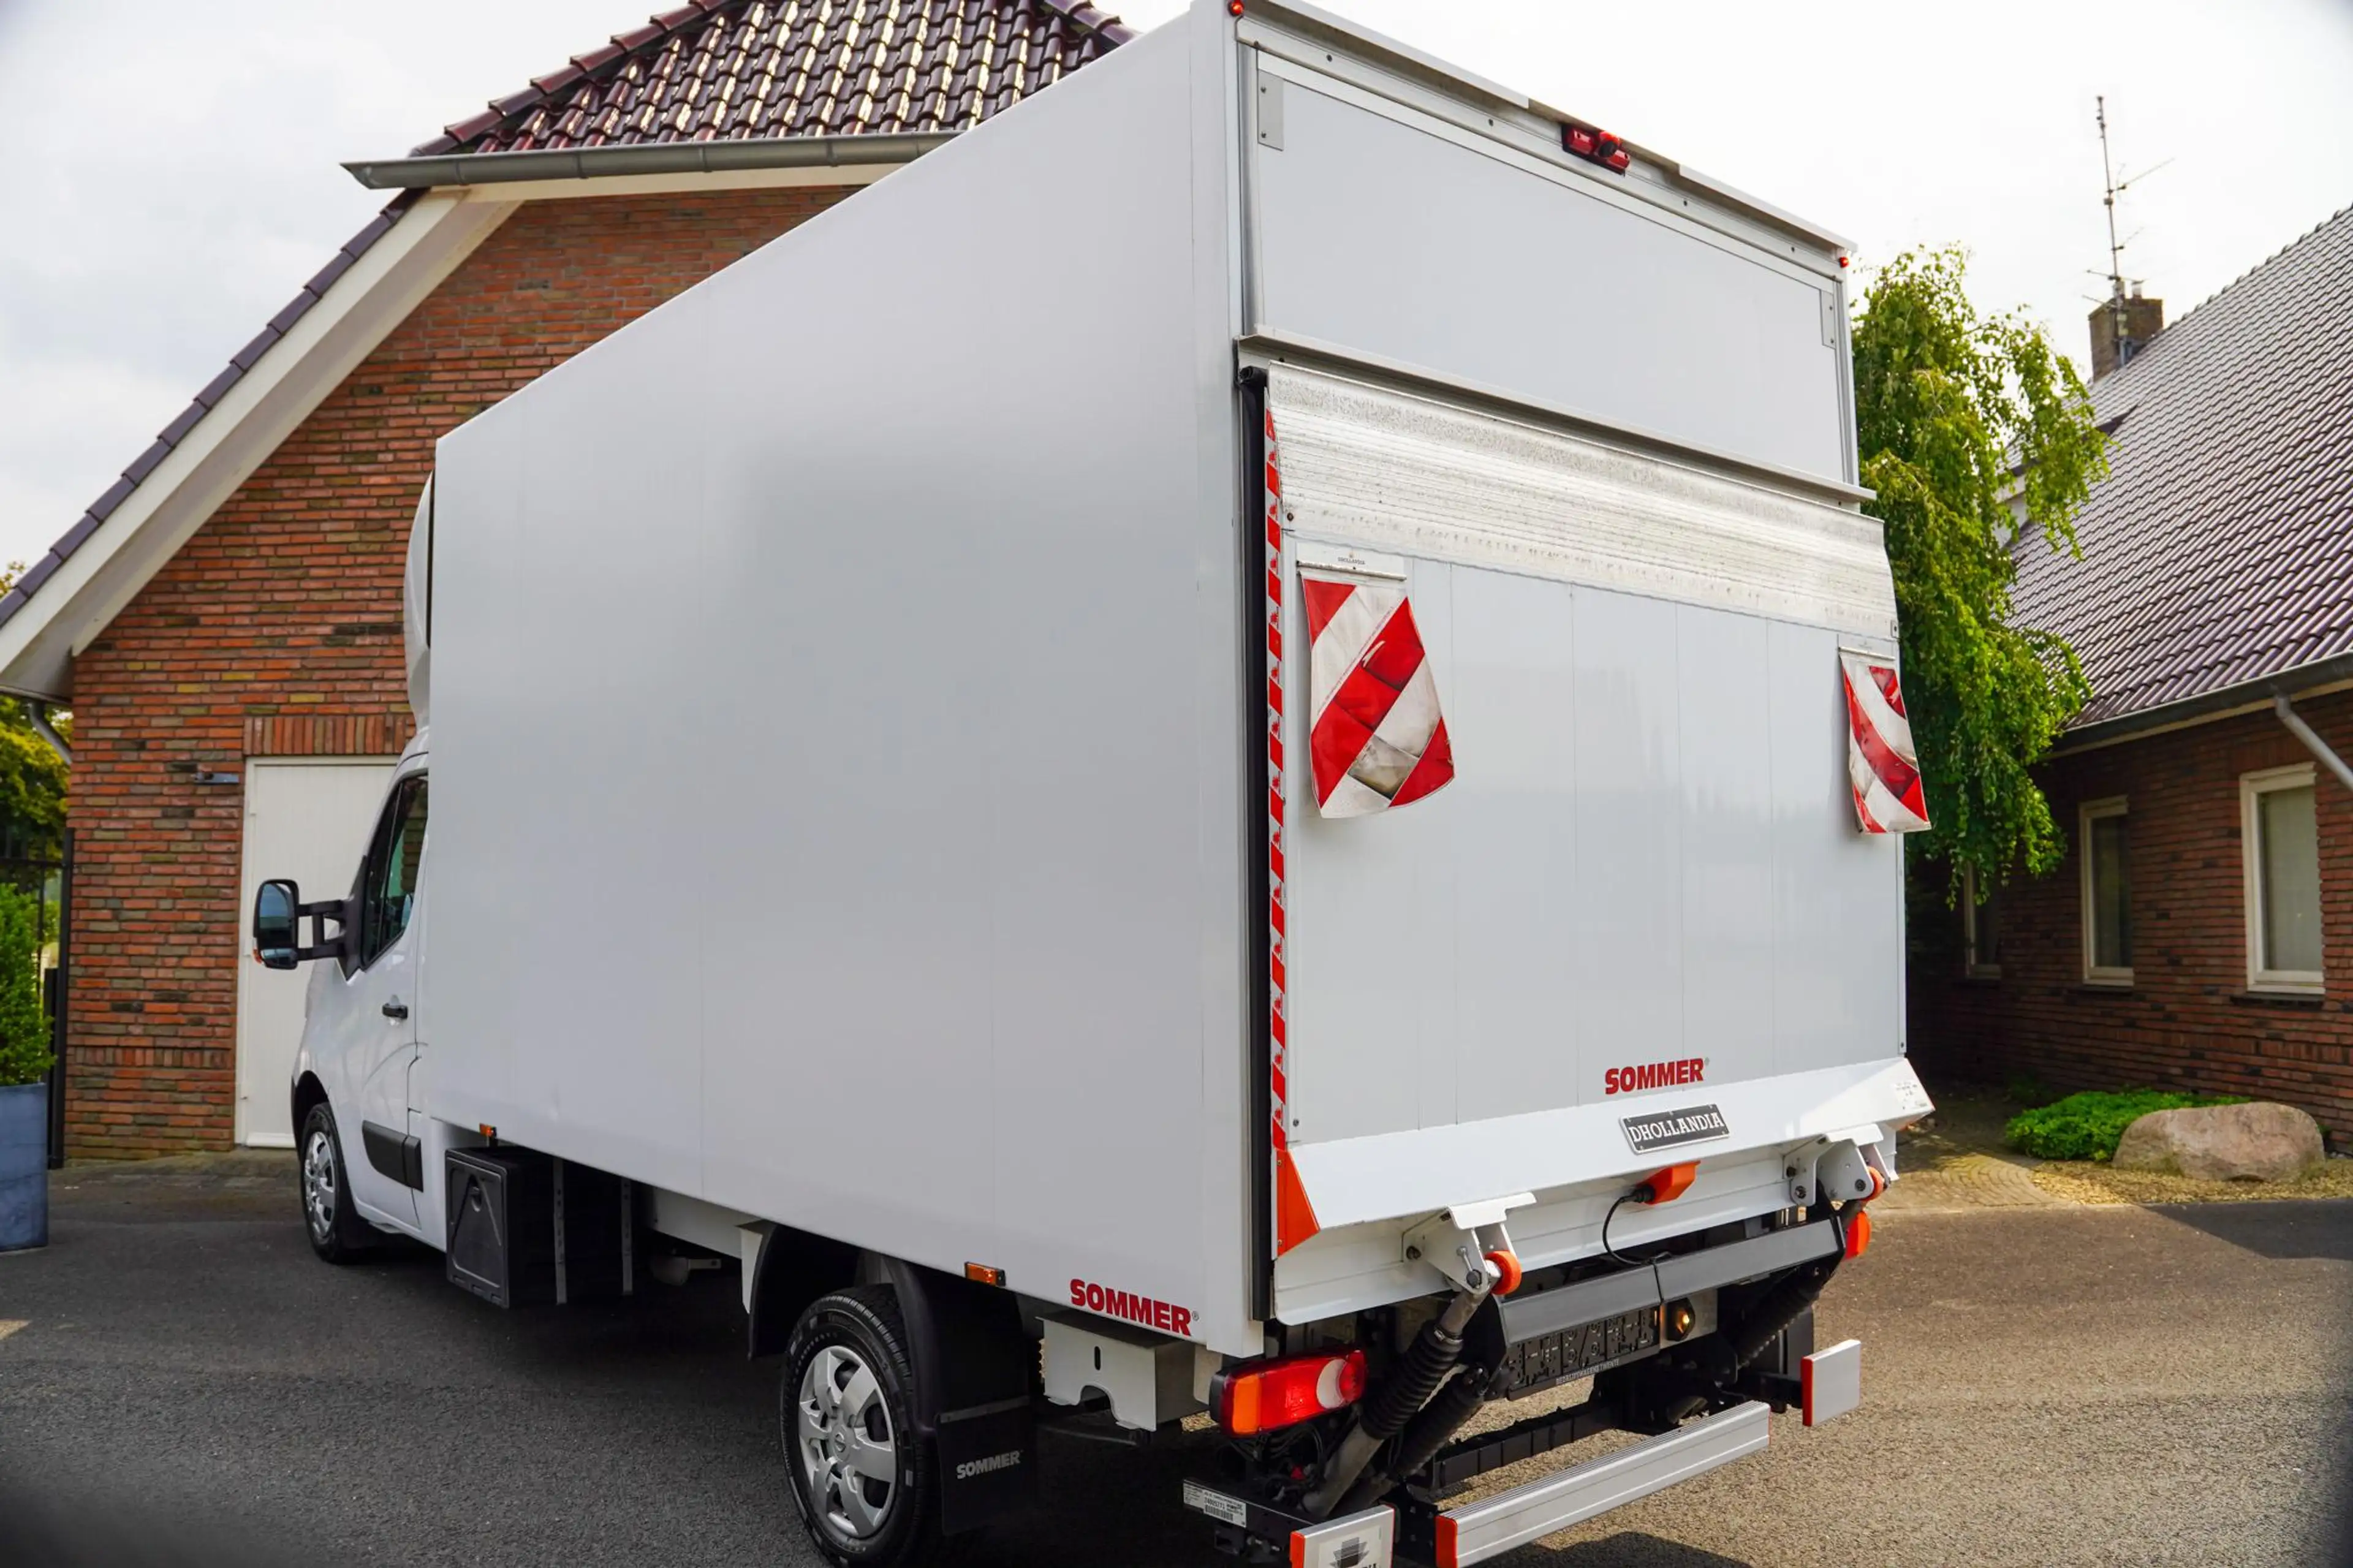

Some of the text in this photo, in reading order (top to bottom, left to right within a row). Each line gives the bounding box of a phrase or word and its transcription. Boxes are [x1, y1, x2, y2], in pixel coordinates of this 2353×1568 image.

[1605, 1058, 1703, 1095] SOMMER
[1629, 1112, 1725, 1142] DHOLLANDIA
[1070, 1278, 1191, 1337] SOMMER
[957, 1450, 1020, 1479] SOMMER
